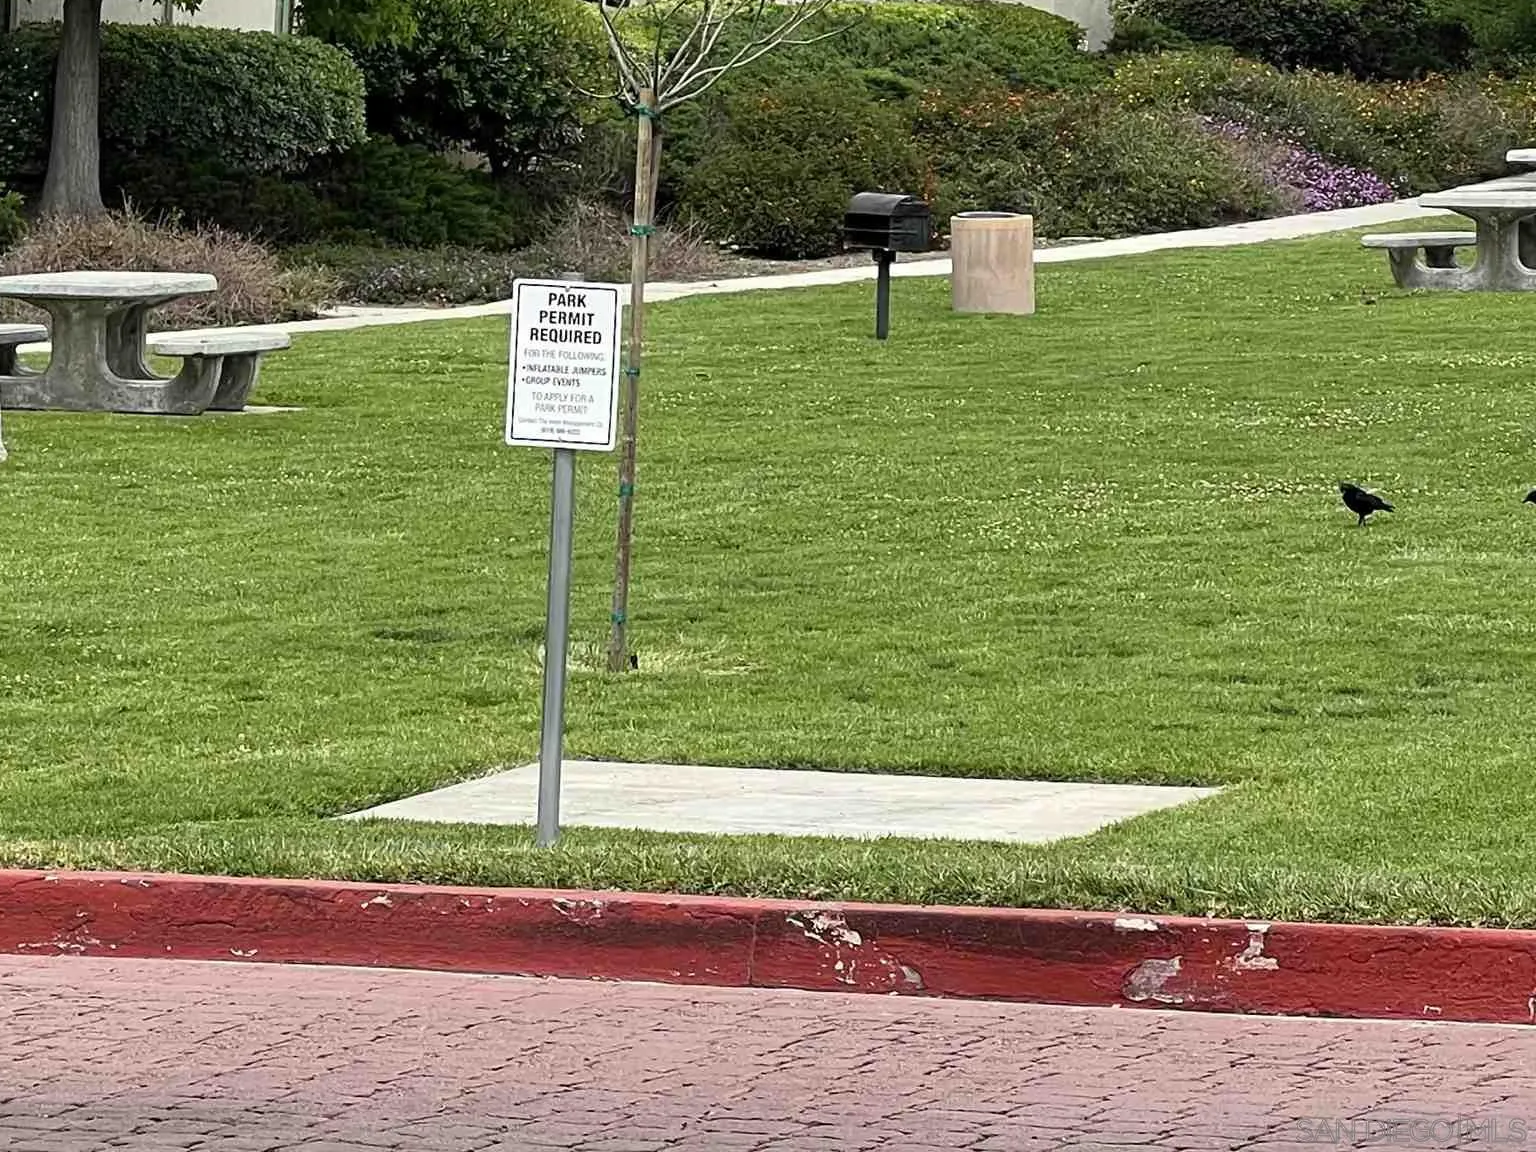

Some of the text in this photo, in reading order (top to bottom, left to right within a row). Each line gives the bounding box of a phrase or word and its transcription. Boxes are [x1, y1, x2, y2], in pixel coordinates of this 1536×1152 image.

[548, 292, 586, 308] PARK
[539, 310, 595, 326] PERMIT
[530, 327, 602, 344] REQUIRED
[544, 392, 569, 402] APPLY
